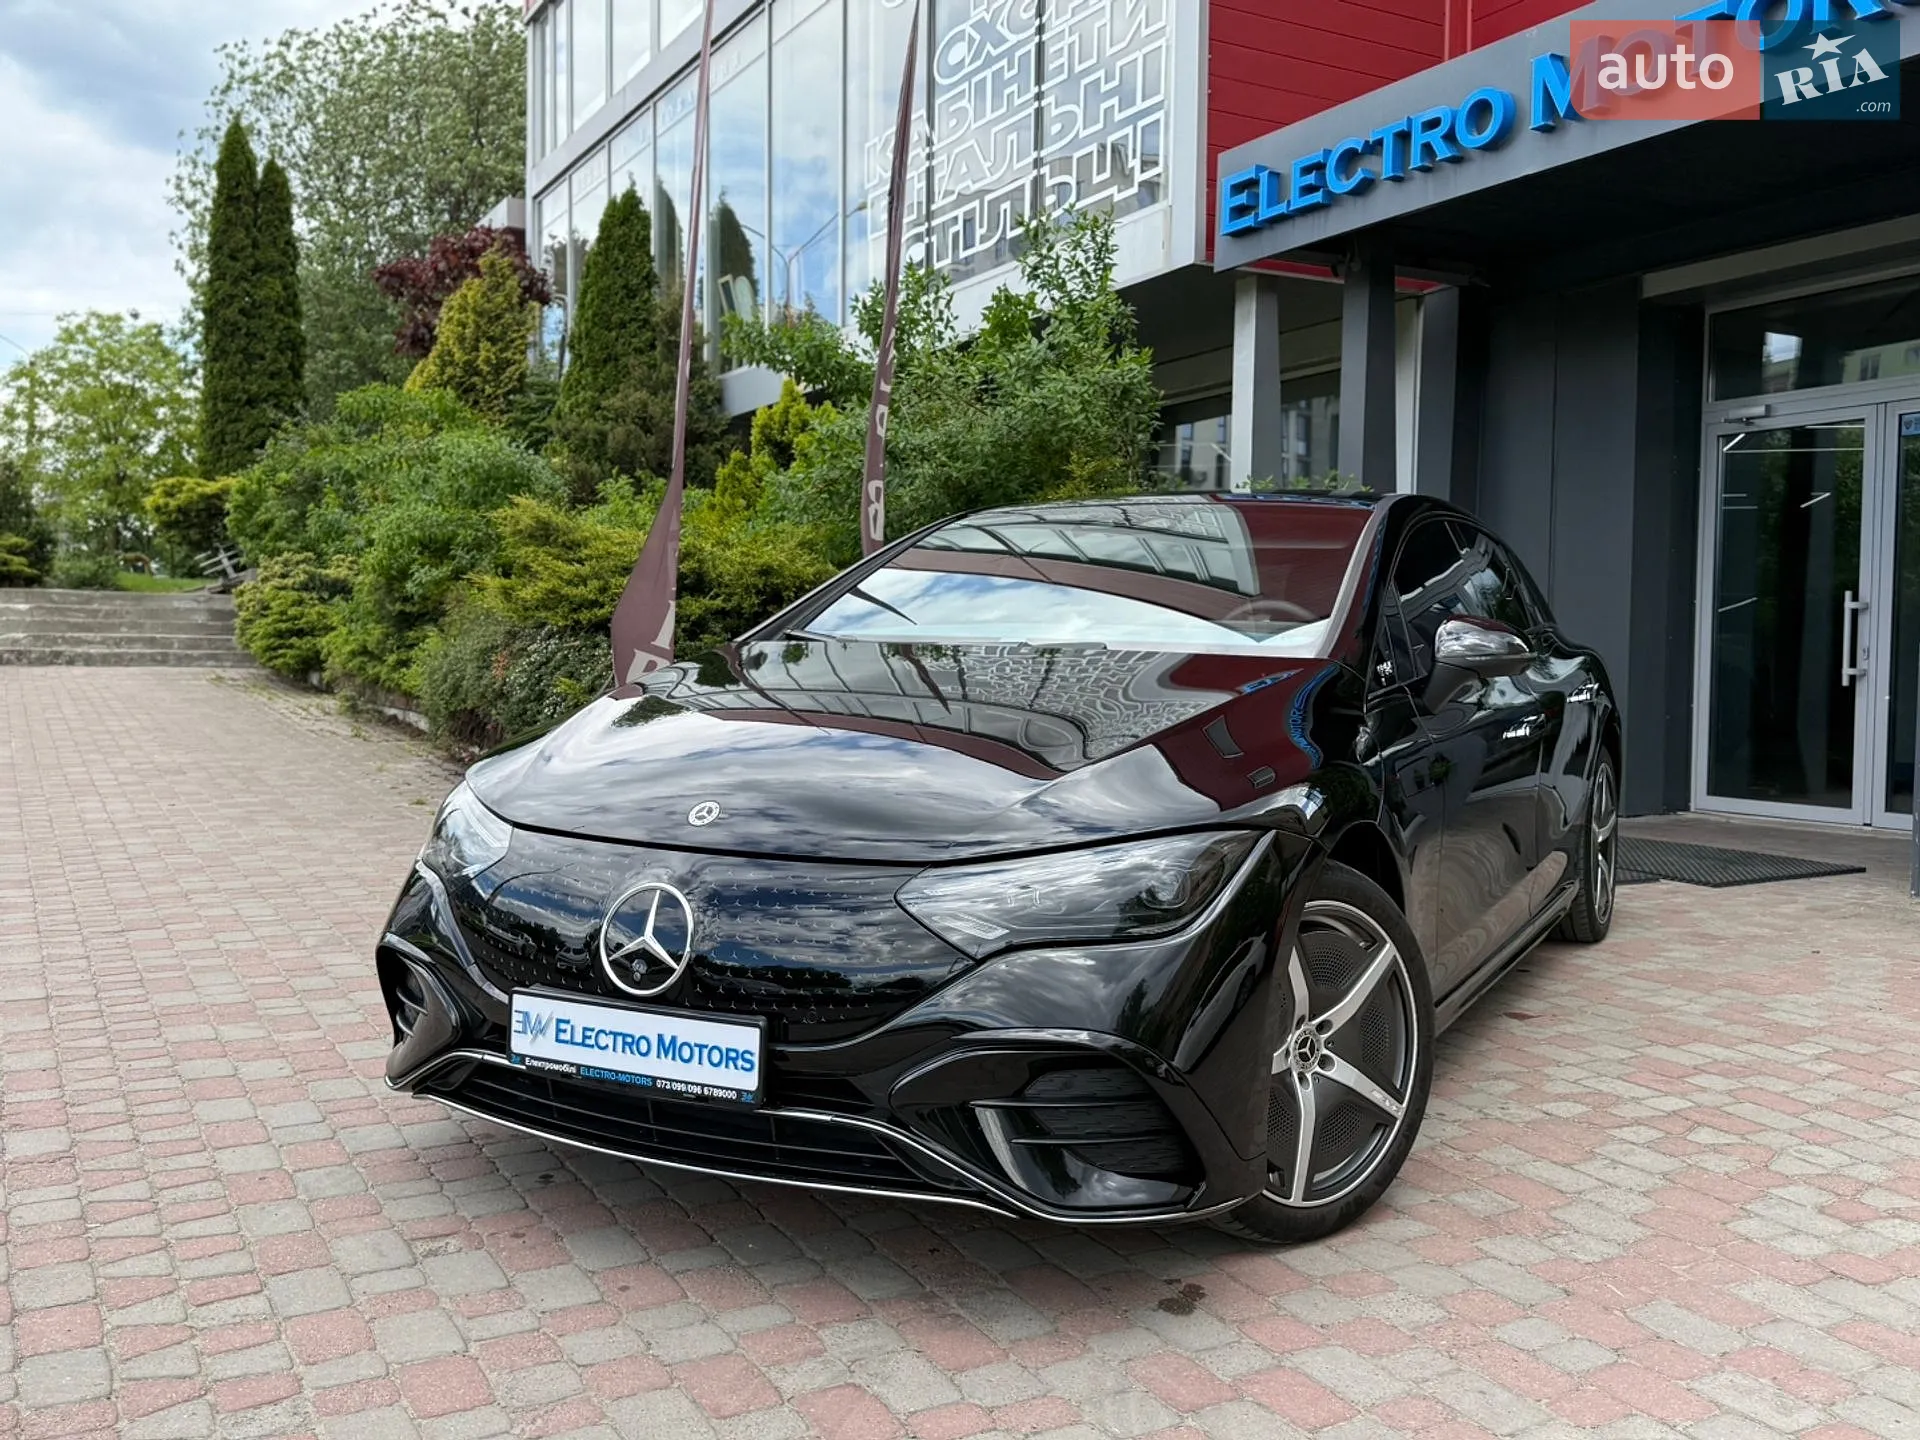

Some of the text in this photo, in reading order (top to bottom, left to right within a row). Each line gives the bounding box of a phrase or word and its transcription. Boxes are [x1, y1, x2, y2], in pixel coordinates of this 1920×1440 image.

[1220, 86, 1515, 236] ELECTRO
[555, 1018, 652, 1057] ELECTRO
[656, 1033, 756, 1072] MOTORS
[580, 1066, 653, 1087] ELECTRO-MOTORS
